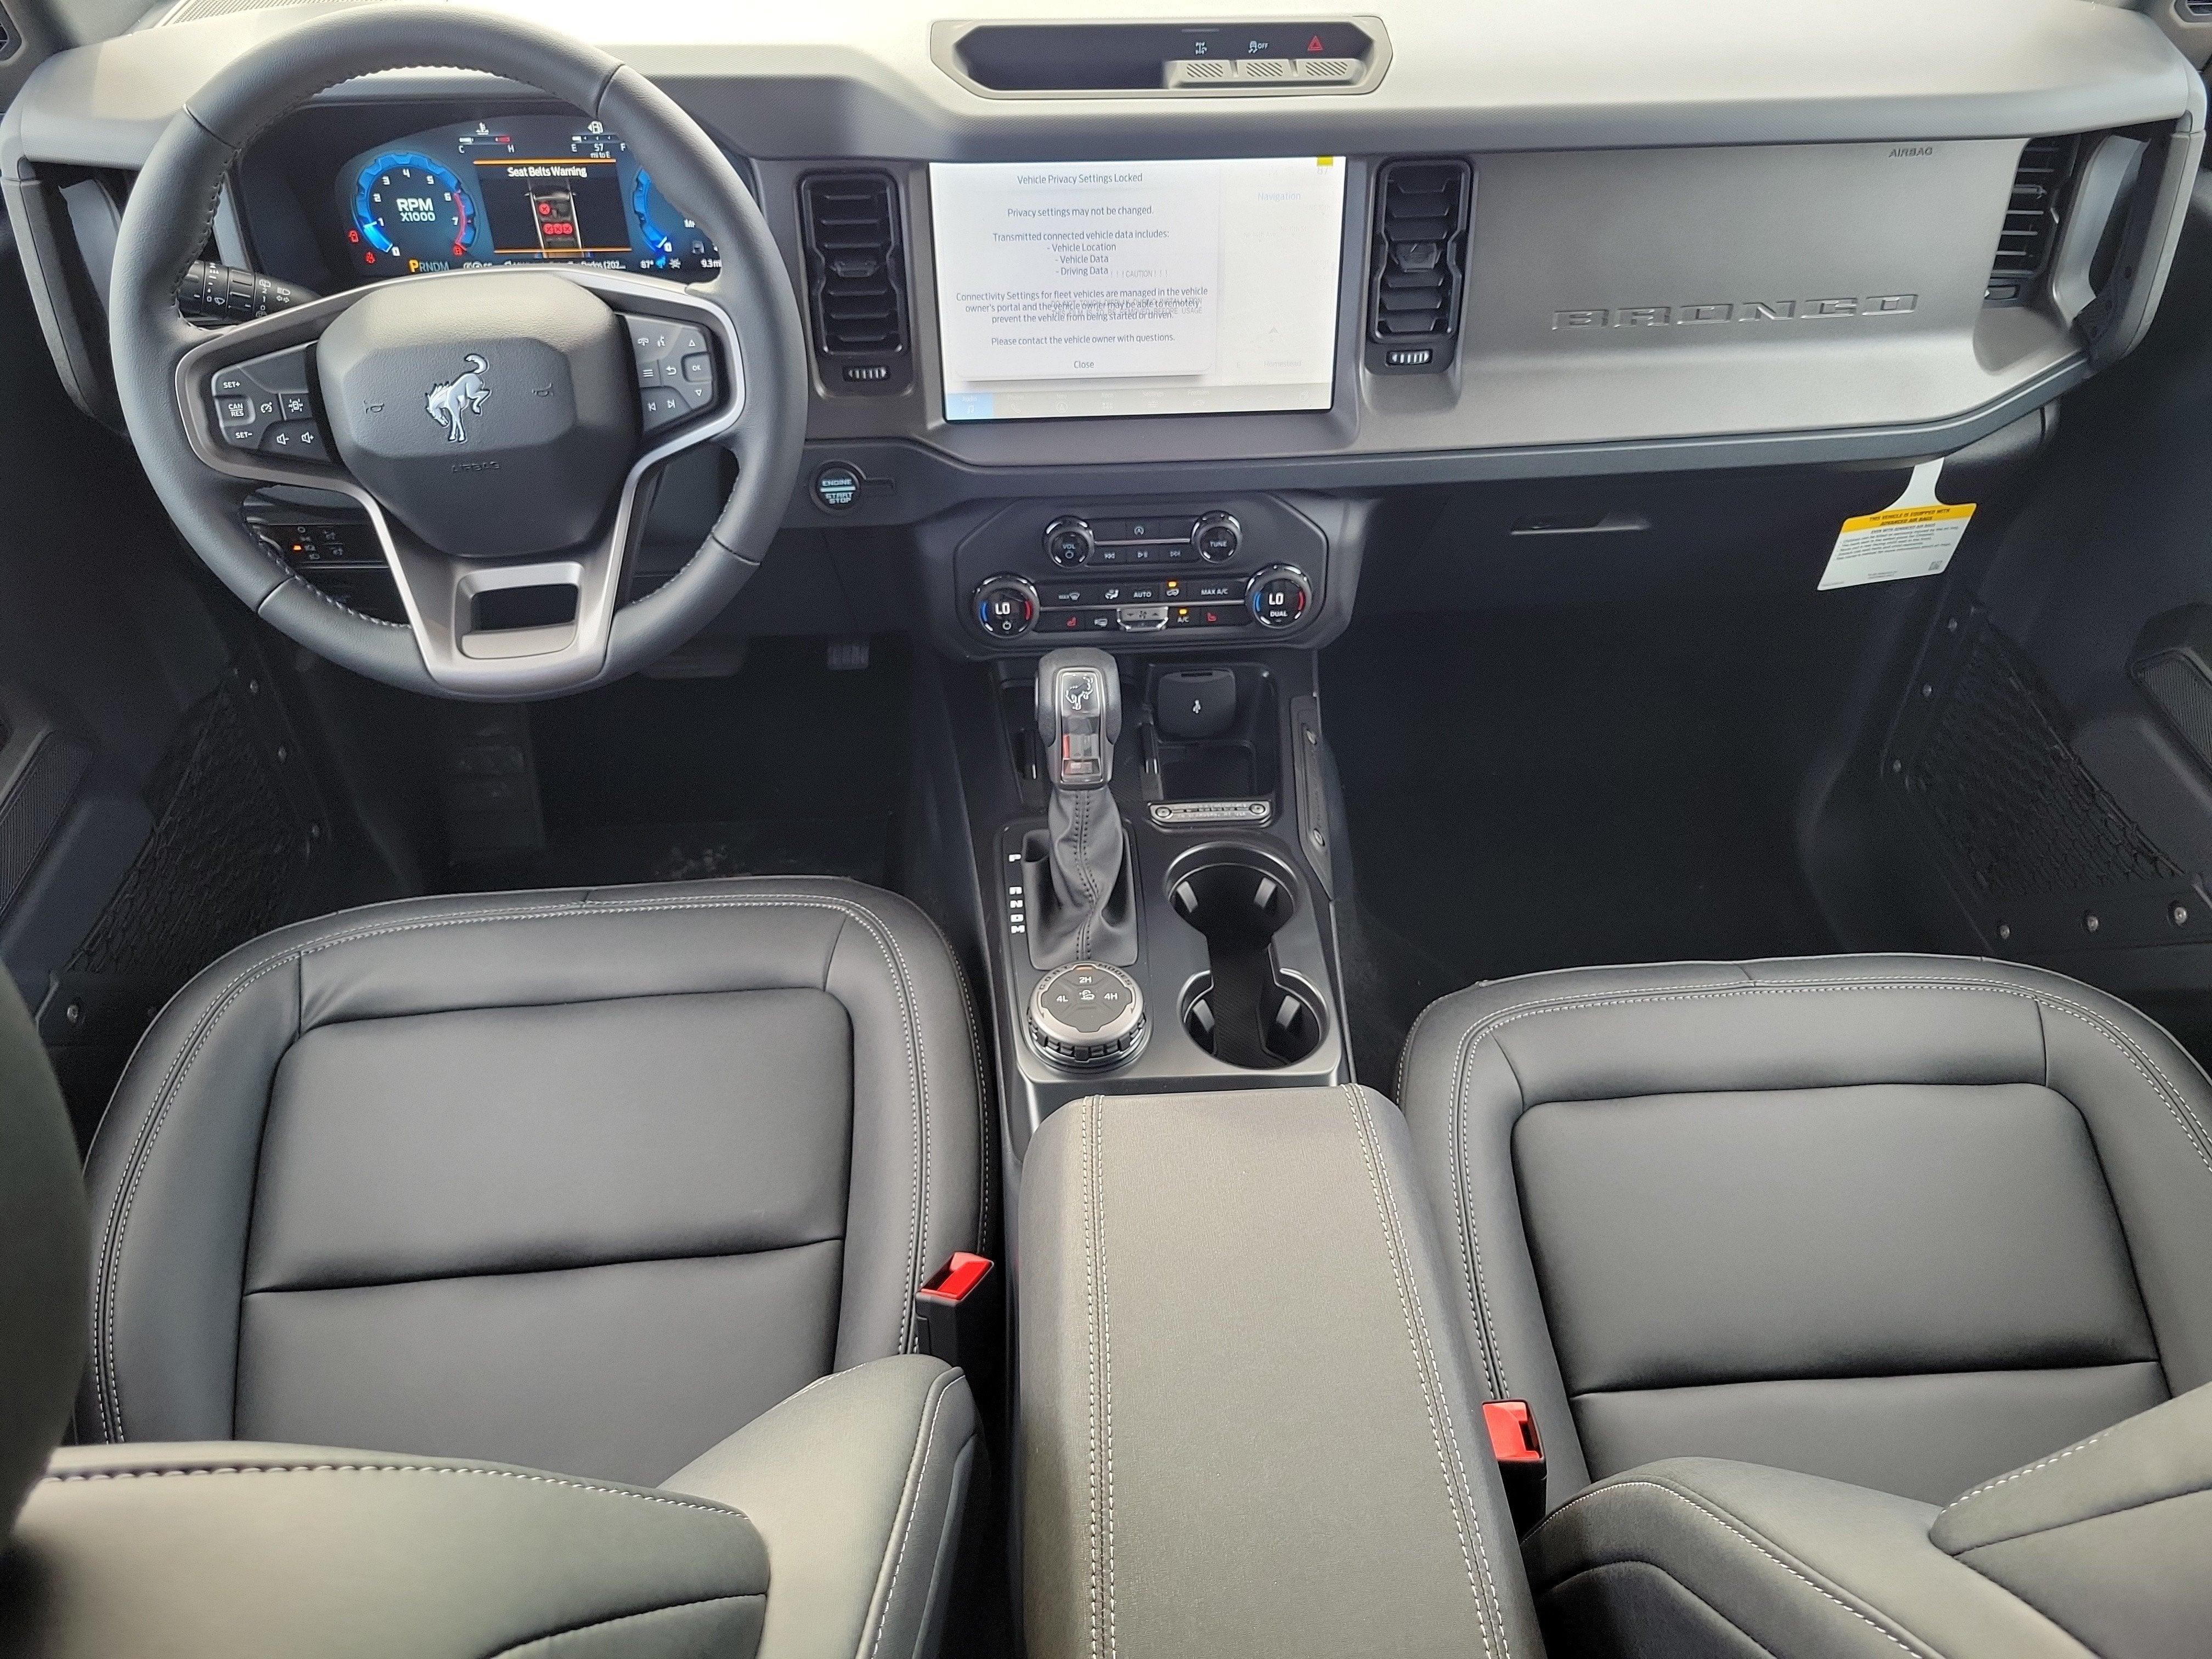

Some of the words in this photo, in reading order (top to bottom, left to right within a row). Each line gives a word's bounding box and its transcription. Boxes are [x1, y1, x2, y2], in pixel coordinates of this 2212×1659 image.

[1257, 42, 1268, 50] OFF
[459, 144, 465, 153] C
[508, 144, 515, 153] H
[572, 144, 578, 152] E
[594, 143, 603, 152] 57
[1888, 146, 1933, 157] AIRBAG
[402, 168, 411, 178] 4
[507, 167, 528, 177] Seat
[529, 166, 549, 177] Belts
[550, 166, 587, 178] Warning
[382, 176, 391, 185] 3
[426, 175, 435, 185] 5
[1017, 175, 1046, 184] Vehicle
[1048, 174, 1077, 185] Privacy
[1079, 173, 1112, 184] Settings
[1114, 173, 1143, 183] Locked
[373, 193, 382, 202] 2
[443, 192, 452, 202] 6
[396, 198, 434, 212] RPM
[400, 211, 436, 222] X1000
[1007, 208, 1036, 218] Privacy
[1038, 207, 1070, 217] settings
[1072, 209, 1089, 217] may
[1118, 206, 1154, 216] changed.
[377, 217, 385, 227] 1
[451, 216, 459, 225] 7
[993, 233, 1042, 242] Transmitted
[1043, 232, 1085, 241] connected
[1086, 231, 1114, 240] vehicle
[1115, 230, 1133, 239] data
[1135, 229, 1170, 239] includes:
[391, 246, 400, 257] 0
[664, 241, 673, 252] 0
[1052, 244, 1080, 252] Vehicle
[1081, 242, 1116, 251] Location
[1060, 256, 1088, 264] Vehicle
[1090, 255, 1109, 263] Data
[1061, 267, 1088, 276] Driving
[1090, 267, 1109, 275] Data
[956, 292, 1005, 301] Connectivity
[1007, 291, 1040, 301] Settings
[1073, 289, 1104, 298] vehicles
[1120, 289, 1156, 298] managed
[1158, 288, 1165, 296] in
[1166, 287, 1180, 296] the
[1181, 287, 1208, 296] vehicle
[966, 304, 995, 312] owner's
[997, 303, 1020, 313] portal
[1022, 303, 1037, 311] and
[1039, 302, 1052, 311] the
[1052, 302, 1081, 310] vehicle
[1107, 302, 1124, 311] may
[1137, 300, 1154, 308] able
[1165, 298, 1199, 308] remotely
[1552, 293, 1918, 330] BRONCO
[992, 315, 1022, 324] prevent
[1023, 314, 1036, 323] the
[1037, 313, 1065, 322] vehicle
[1066, 313, 1085, 321] from
[1086, 312, 1108, 322] being
[1109, 312, 1138, 320] started
[1147, 311, 1173, 319] driven.
[991, 337, 1017, 346] Please
[1018, 337, 1048, 345] contact
[1049, 336, 1062, 345] the
[1064, 336, 1090, 345] vehicle
[1117, 335, 1135, 343] with
[1136, 334, 1175, 344] questions.
[1074, 360, 1094, 369] Close
[223, 381, 240, 389] SET+
[1268, 592, 1284, 606] LO
[995, 601, 1011, 616] LO
[1008, 854, 1022, 862] P
[1010, 900, 1023, 909] N
[1011, 925, 1025, 934] M
[1056, 995, 1069, 1003] 4L
